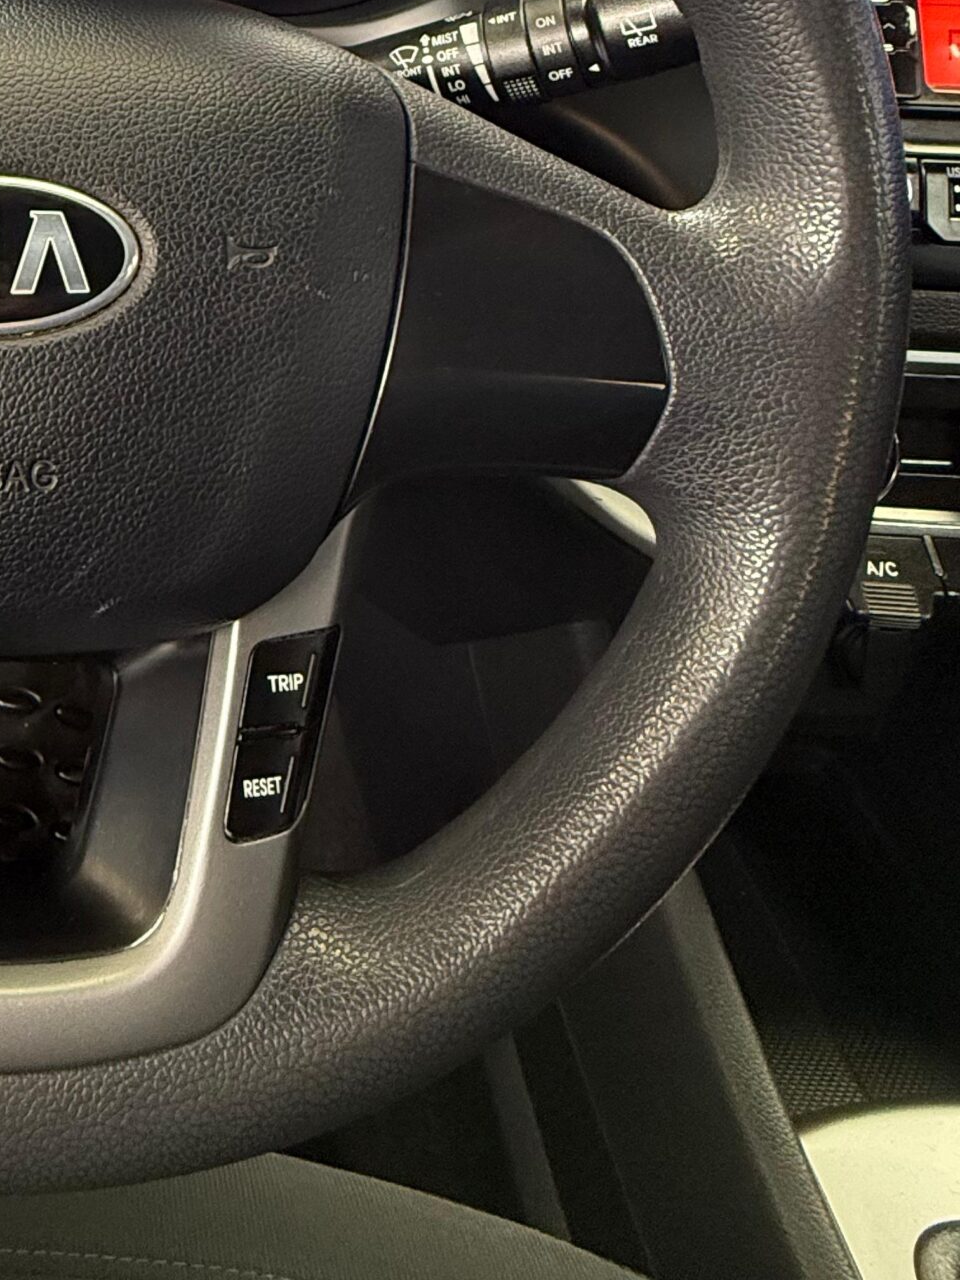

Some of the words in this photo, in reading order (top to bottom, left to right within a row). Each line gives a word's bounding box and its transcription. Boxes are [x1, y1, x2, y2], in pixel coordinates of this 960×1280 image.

[496, 11, 517, 24] INT
[535, 15, 556, 29] ON
[431, 31, 458, 48] MIST
[627, 34, 658, 49] REAR
[436, 47, 459, 62] OFF
[542, 41, 563, 56] INT
[441, 63, 461, 77] INT
[548, 67, 574, 82] OFF
[448, 80, 466, 92] LO
[866, 560, 899, 577] A/C
[266, 673, 304, 693] TRIP
[242, 775, 282, 798] RESET
